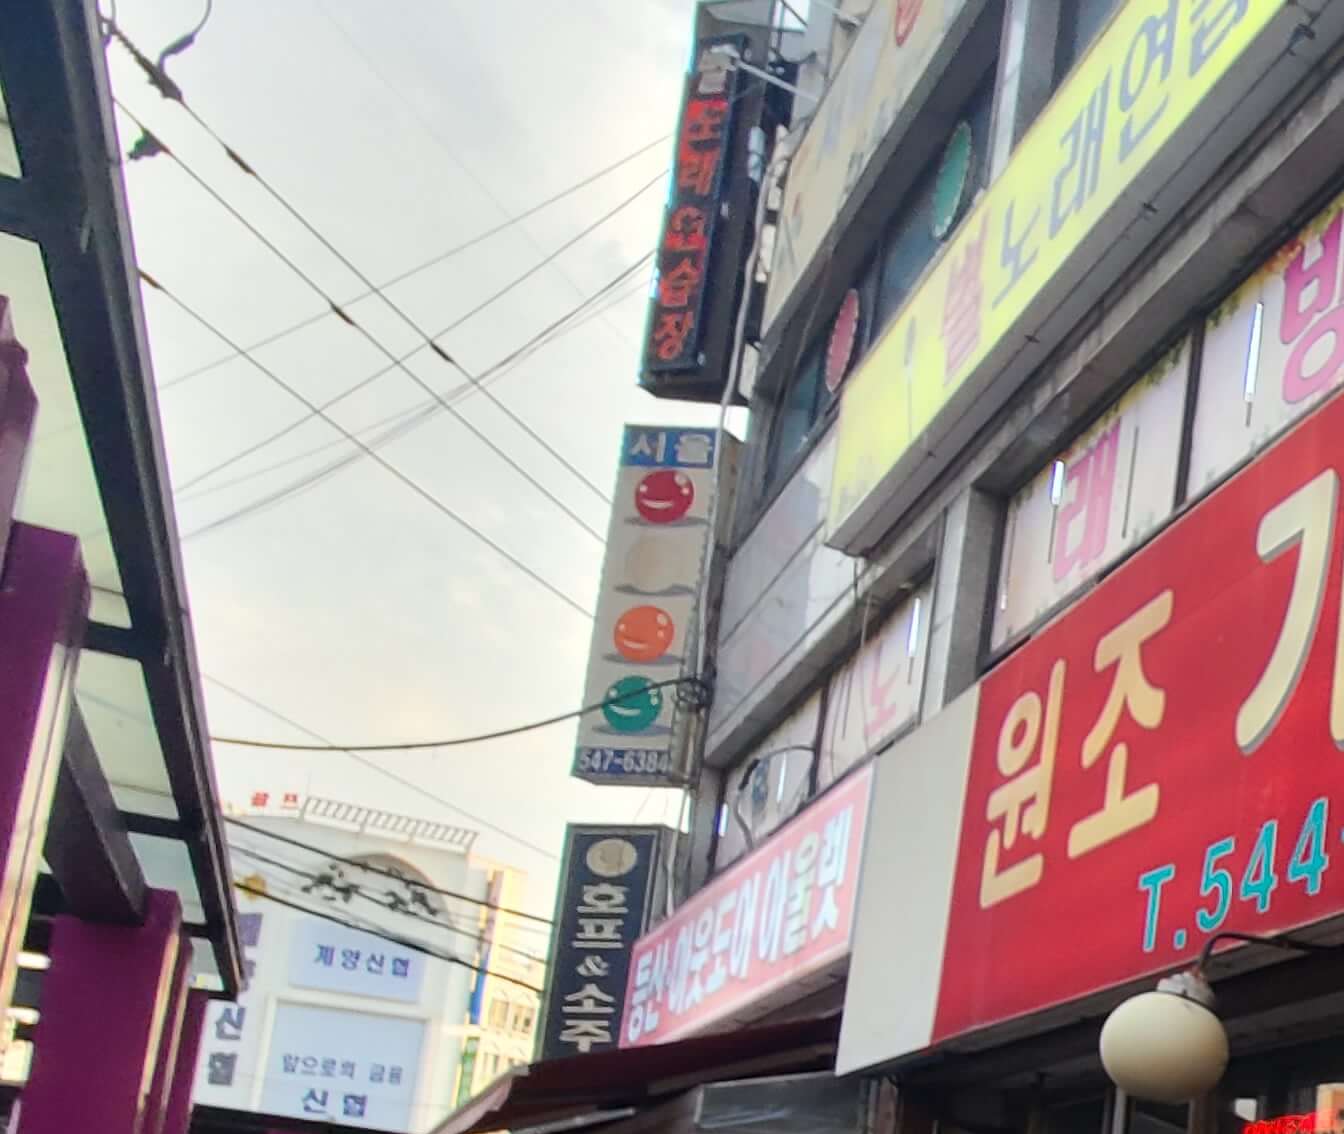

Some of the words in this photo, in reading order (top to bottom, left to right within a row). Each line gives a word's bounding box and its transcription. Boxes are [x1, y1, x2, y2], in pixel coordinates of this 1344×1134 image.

[979, 587, 1175, 908] 원조
[574, 883, 629, 949] 호프
[759, 804, 854, 964] 아울렛
[559, 982, 616, 1053] 소주
[302, 1088, 368, 1118] 신협
